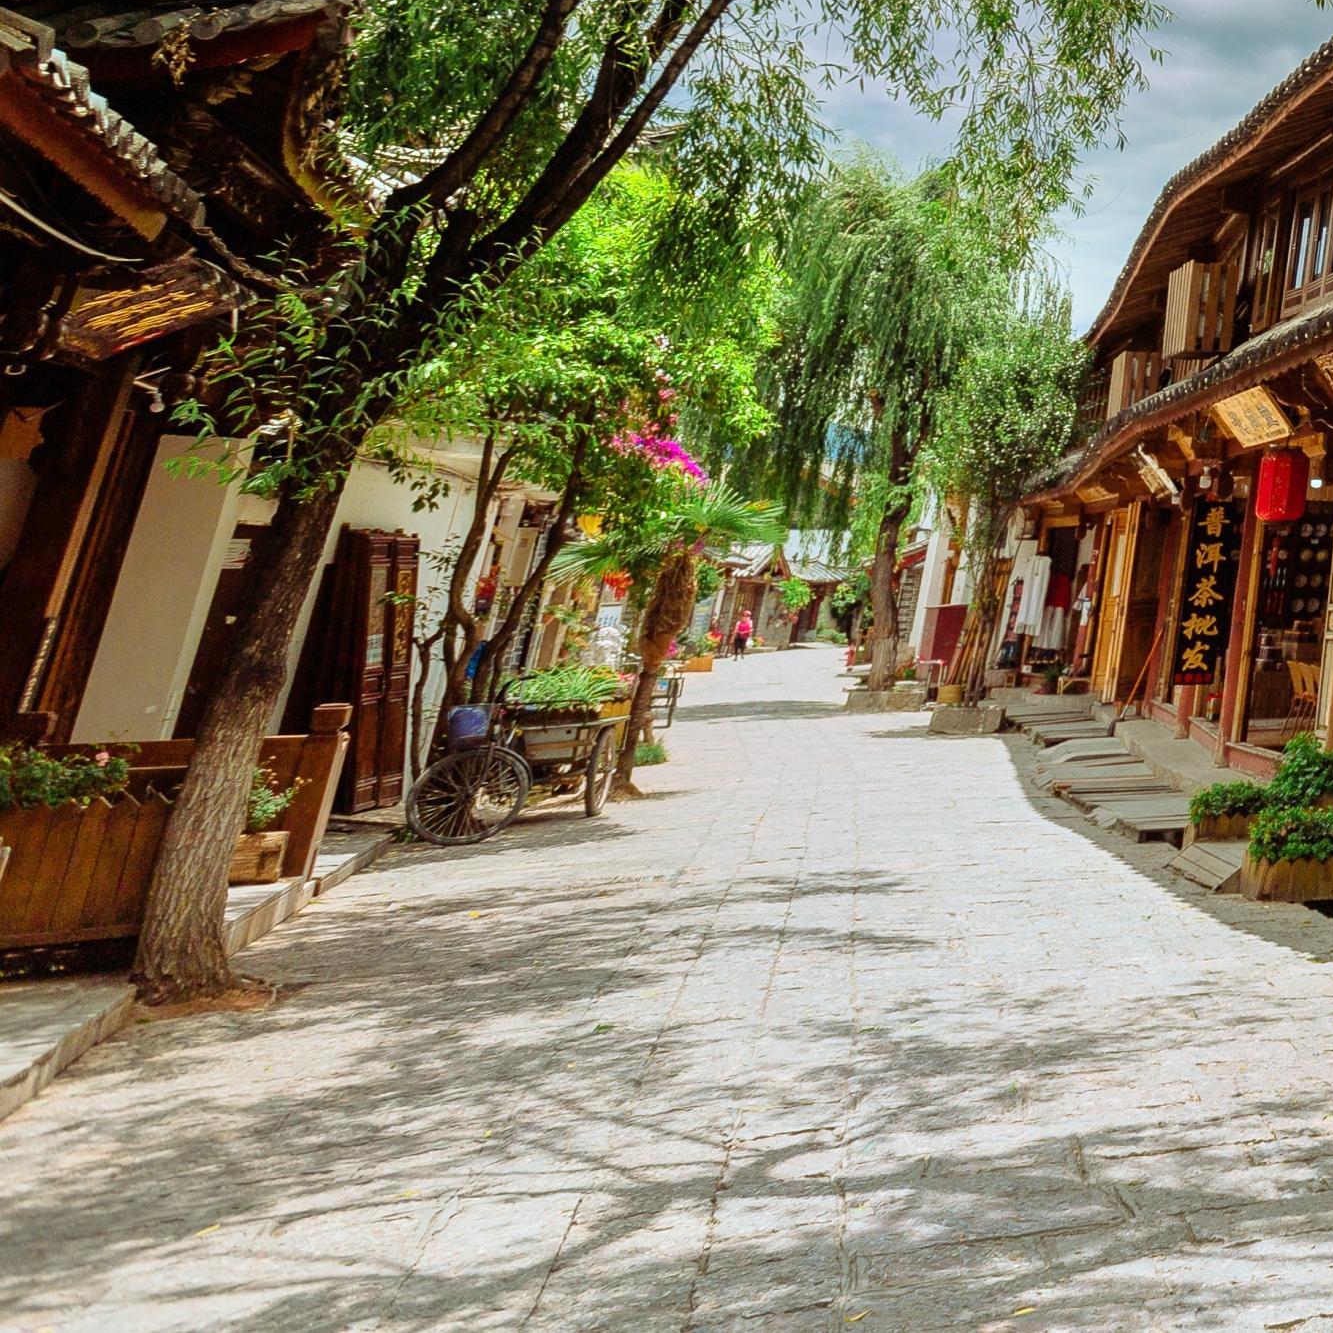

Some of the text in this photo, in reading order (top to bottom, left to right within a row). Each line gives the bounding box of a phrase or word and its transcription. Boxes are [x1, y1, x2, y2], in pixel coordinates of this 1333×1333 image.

[1182, 506, 1231, 671] 普洱茶批发
